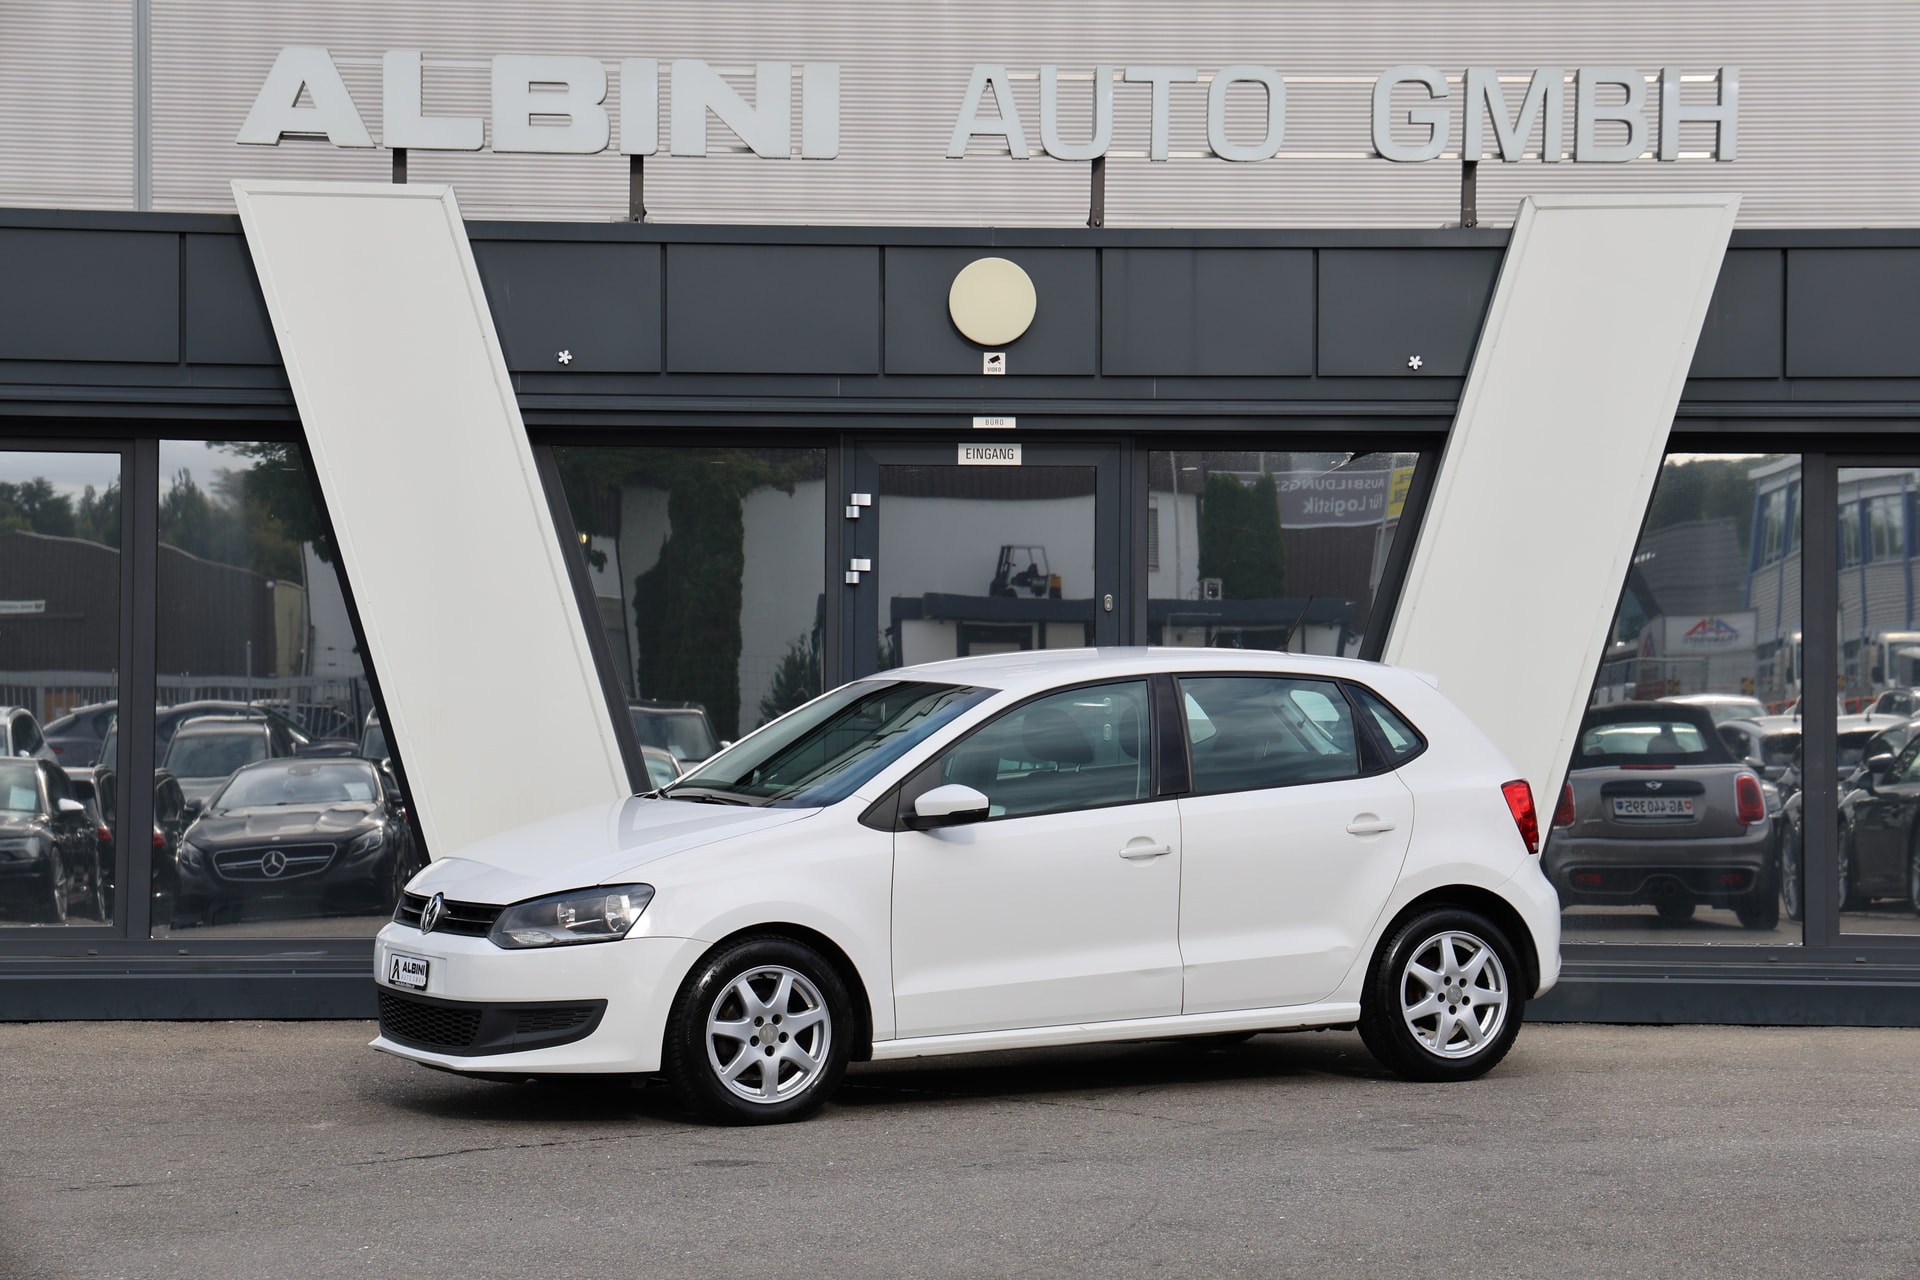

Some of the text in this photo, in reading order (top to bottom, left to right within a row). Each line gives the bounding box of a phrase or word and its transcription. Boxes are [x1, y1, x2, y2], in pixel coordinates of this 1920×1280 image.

[235, 46, 1740, 163] ALBINI AUTO GMBH
[985, 418, 1004, 426] BÜRO
[966, 448, 1014, 460] EINGANG
[402, 961, 426, 976] ALBINI
